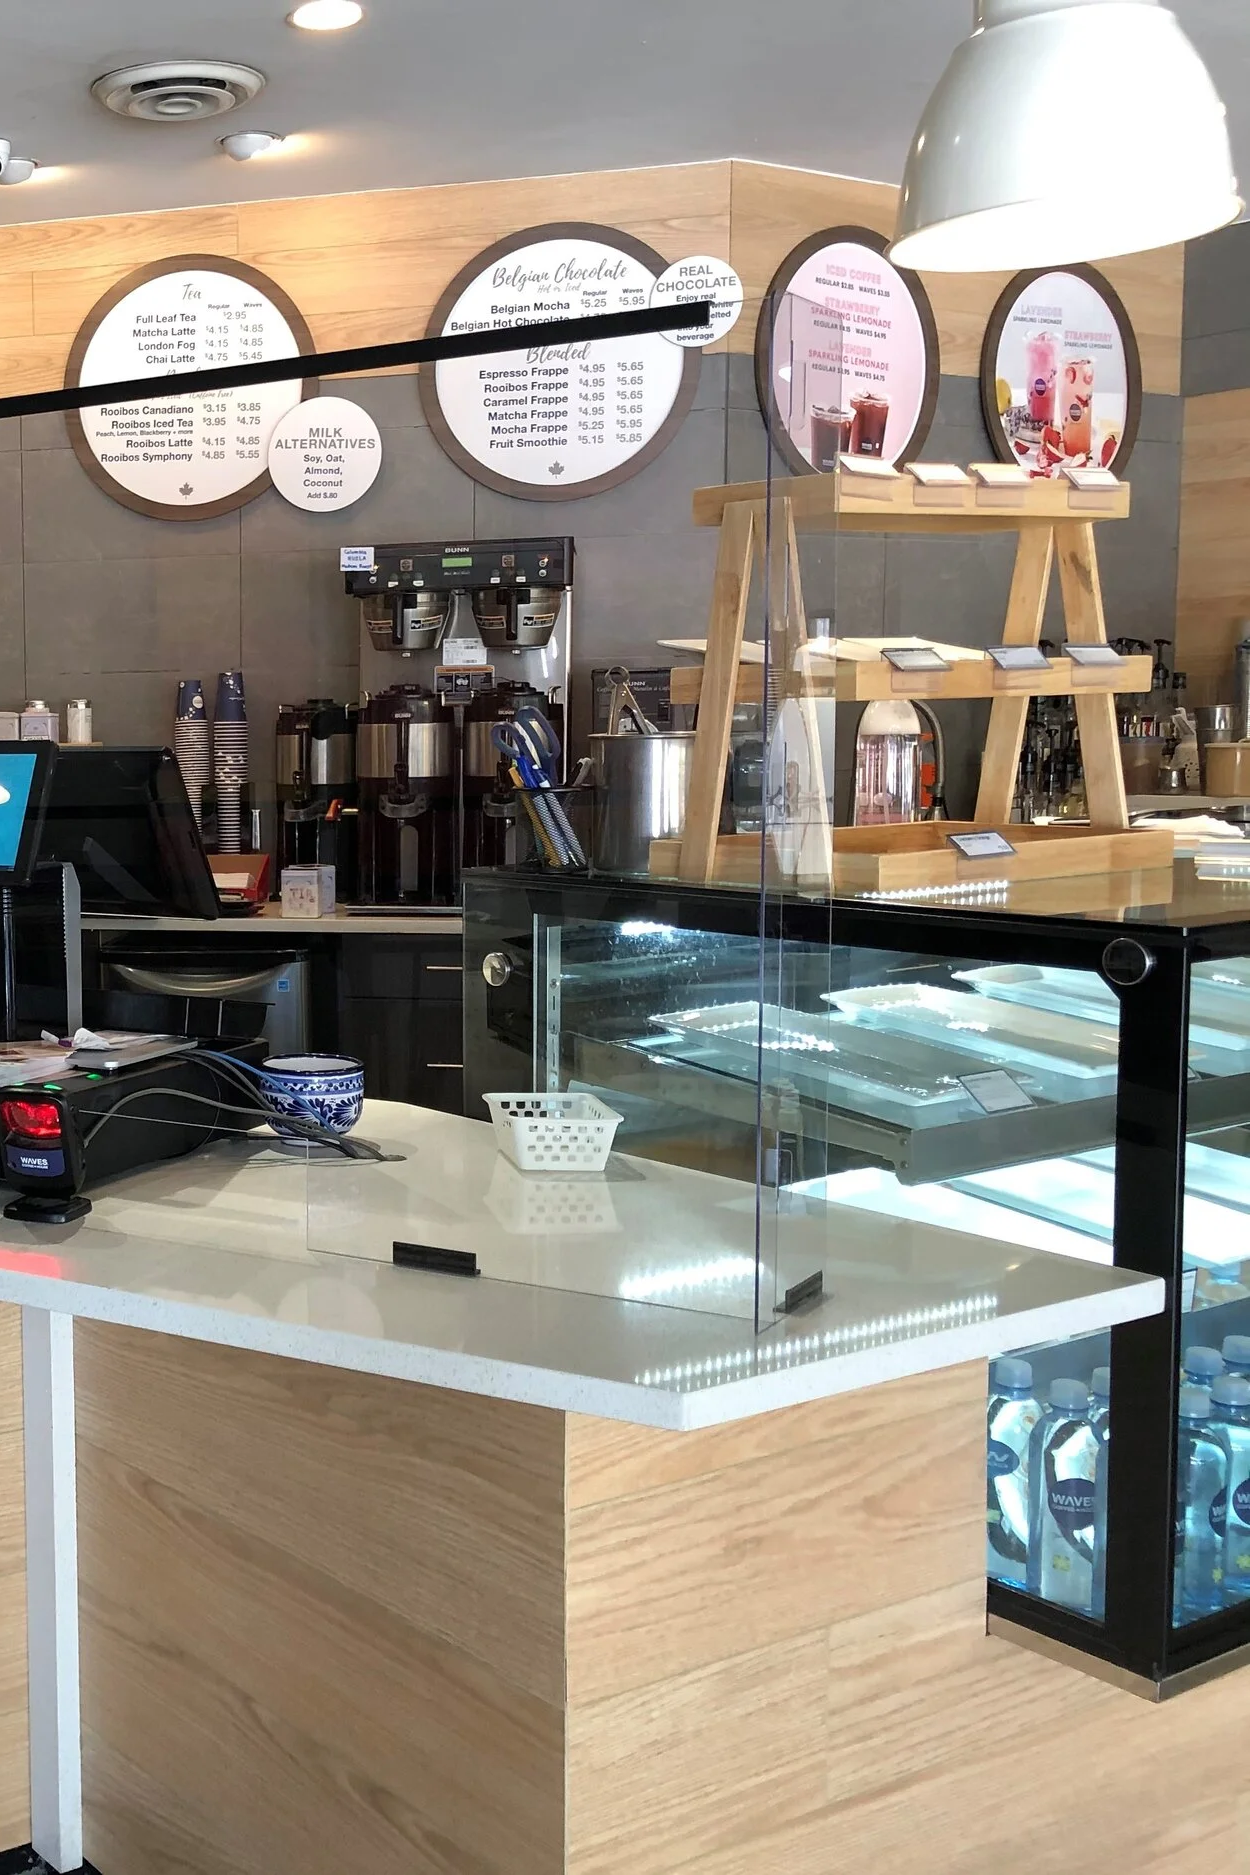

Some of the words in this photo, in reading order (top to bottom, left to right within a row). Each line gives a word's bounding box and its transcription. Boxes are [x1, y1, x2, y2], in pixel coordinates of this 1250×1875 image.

[493, 265, 550, 292] Belgian
[554, 258, 627, 283] Chocolate
[680, 265, 713, 276] REAL
[850, 269, 881, 284] COFFEE
[657, 276, 736, 292] CHOCOLATE
[816, 277, 840, 286] REGULAR
[859, 286, 876, 294] WAVES
[183, 283, 202, 300] Tea
[582, 289, 607, 297] Regular
[491, 303, 530, 315] Belgian
[534, 302, 570, 311] Mocha
[581, 298, 607, 308] $5.25
[619, 296, 645, 305] $5.95
[676, 295, 698, 303] Enjoy
[825, 297, 880, 316] STRAWBERRY
[156, 315, 176, 323] Leaf
[451, 320, 490, 332] Belgian
[493, 319, 512, 328] Hot
[853, 315, 891, 329] LEMONADE
[133, 329, 168, 337] Matcha
[172, 328, 195, 336] Latte
[814, 320, 838, 329] REGULAR
[855, 328, 872, 336] WAVES
[677, 333, 714, 341] beverage
[138, 343, 174, 351] London
[177, 341, 195, 350] Fog
[146, 355, 168, 364] Chai
[171, 355, 195, 363] Latte
[527, 342, 591, 364] Blended
[809, 349, 848, 363] SPARKLING
[851, 357, 889, 371] LEMONADE
[479, 369, 528, 380] Espresso
[532, 367, 569, 377] Frappe
[579, 364, 606, 373] $4.95
[617, 362, 644, 371] $5.65
[812, 363, 836, 372] REGULAR
[855, 371, 871, 379] WAVES
[484, 383, 528, 393] Rooibos
[531, 382, 568, 391] Frappe
[579, 378, 605, 387] $4.95
[617, 376, 643, 385] $5.65
[484, 397, 528, 407] Caramel
[531, 396, 568, 406] Frappe
[579, 392, 605, 401] $4.95
[617, 391, 643, 400] $5.65
[101, 407, 139, 416] Rooibos
[143, 406, 194, 415] Canadiano
[488, 411, 527, 421] Matcha
[531, 410, 568, 420] Frappe
[579, 407, 604, 416] $4.95
[617, 405, 643, 414] $5.65
[111, 420, 150, 429] Rooibos
[154, 420, 174, 428] Iced
[177, 419, 193, 427] Tea
[491, 426, 527, 435] Mocha
[530, 424, 568, 434] Frappe
[579, 421, 604, 430] $5.25
[616, 419, 642, 428] $5.95
[309, 428, 342, 437] MILK
[126, 440, 165, 448] Rooibos
[168, 439, 193, 447] Latte
[275, 439, 375, 449] ALTERNATIVES
[490, 440, 513, 449] Fruit
[517, 437, 567, 447] Smoothie
[578, 435, 604, 444] $5.15
[616, 433, 642, 442] $5.85
[101, 454, 139, 462] Rooibos
[143, 453, 192, 462] Symphony
[303, 455, 323, 463] Soy,
[326, 454, 345, 463] Oat,
[304, 467, 342, 475] Almond,
[303, 479, 343, 487] Coconut
[21, 1157, 48, 1165] WAVES
